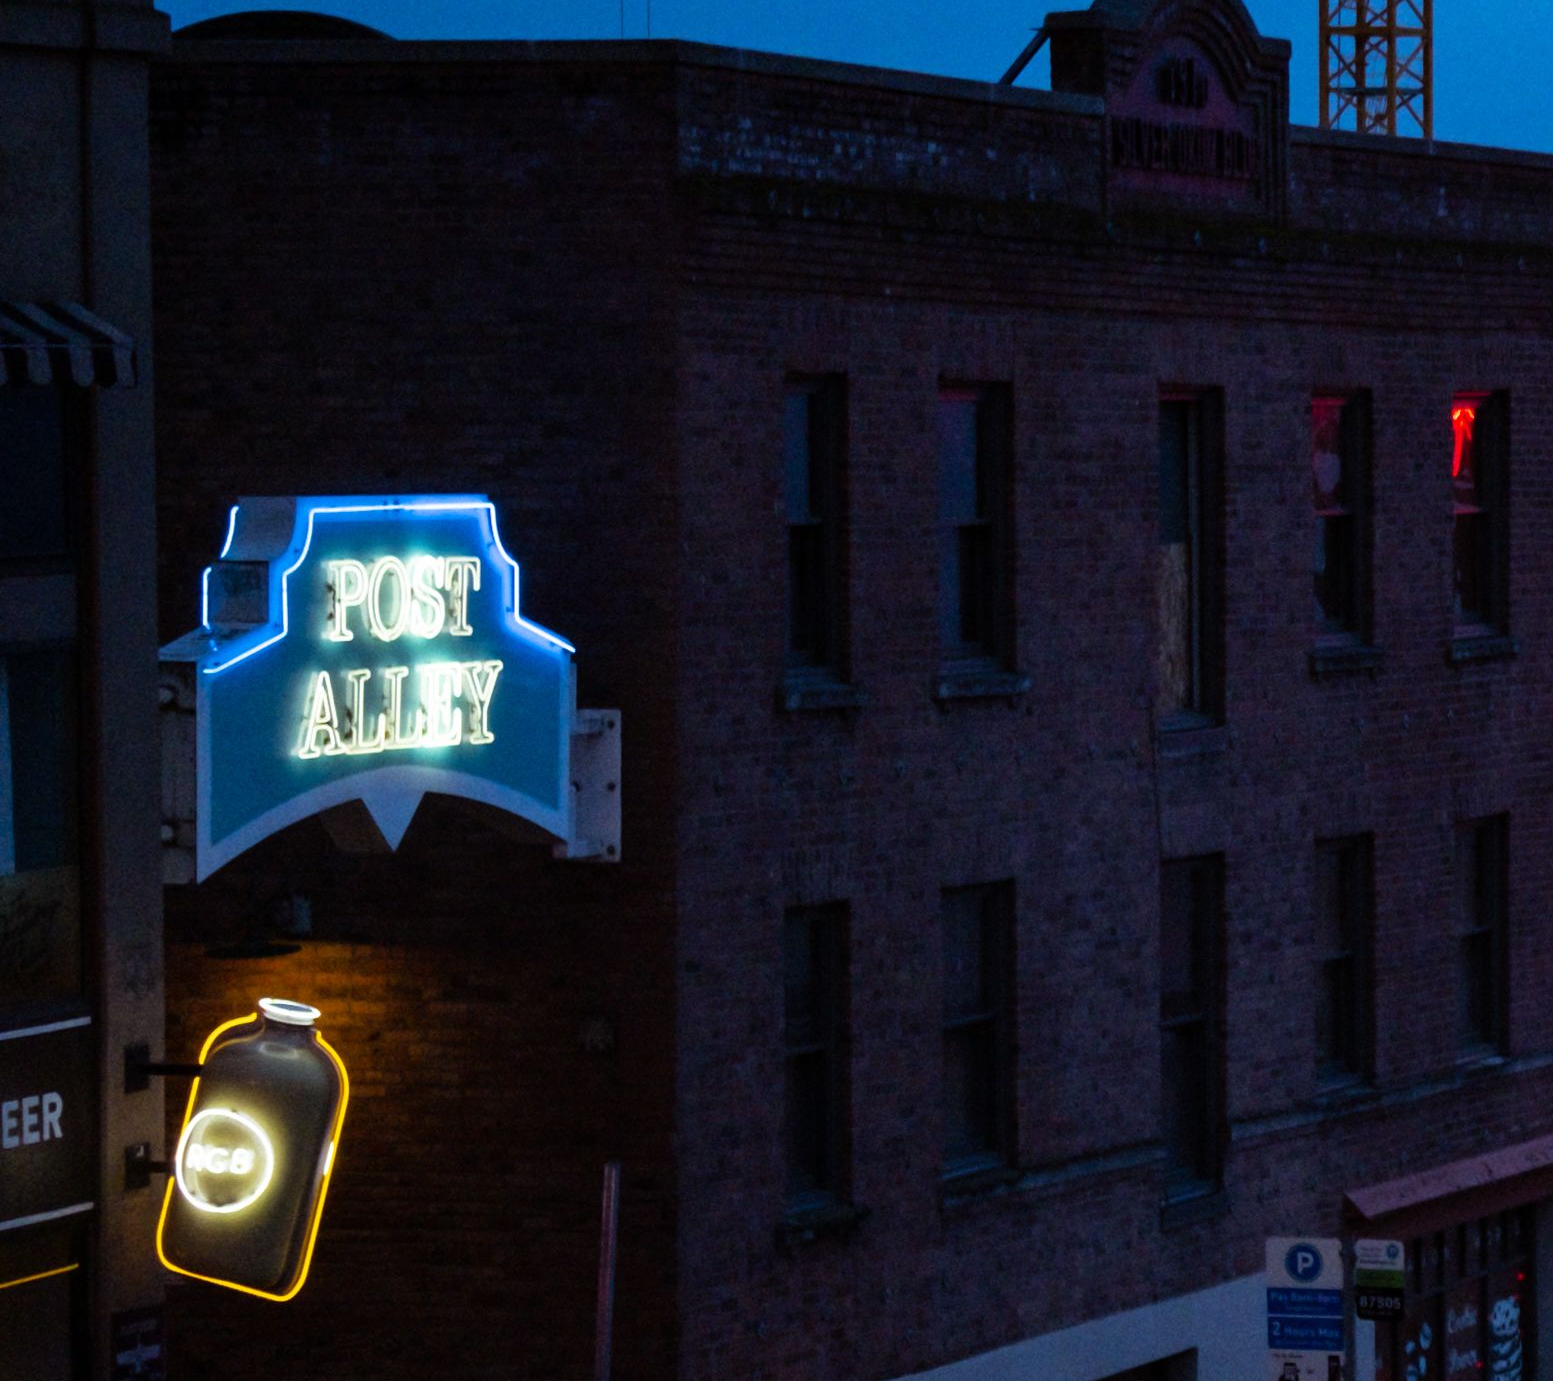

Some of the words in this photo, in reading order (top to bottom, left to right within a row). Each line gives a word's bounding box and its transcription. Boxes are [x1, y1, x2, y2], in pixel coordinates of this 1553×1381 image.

[327, 555, 481, 642] POST
[297, 659, 504, 759] ALLEY
[1272, 1322, 1281, 1336] 2
